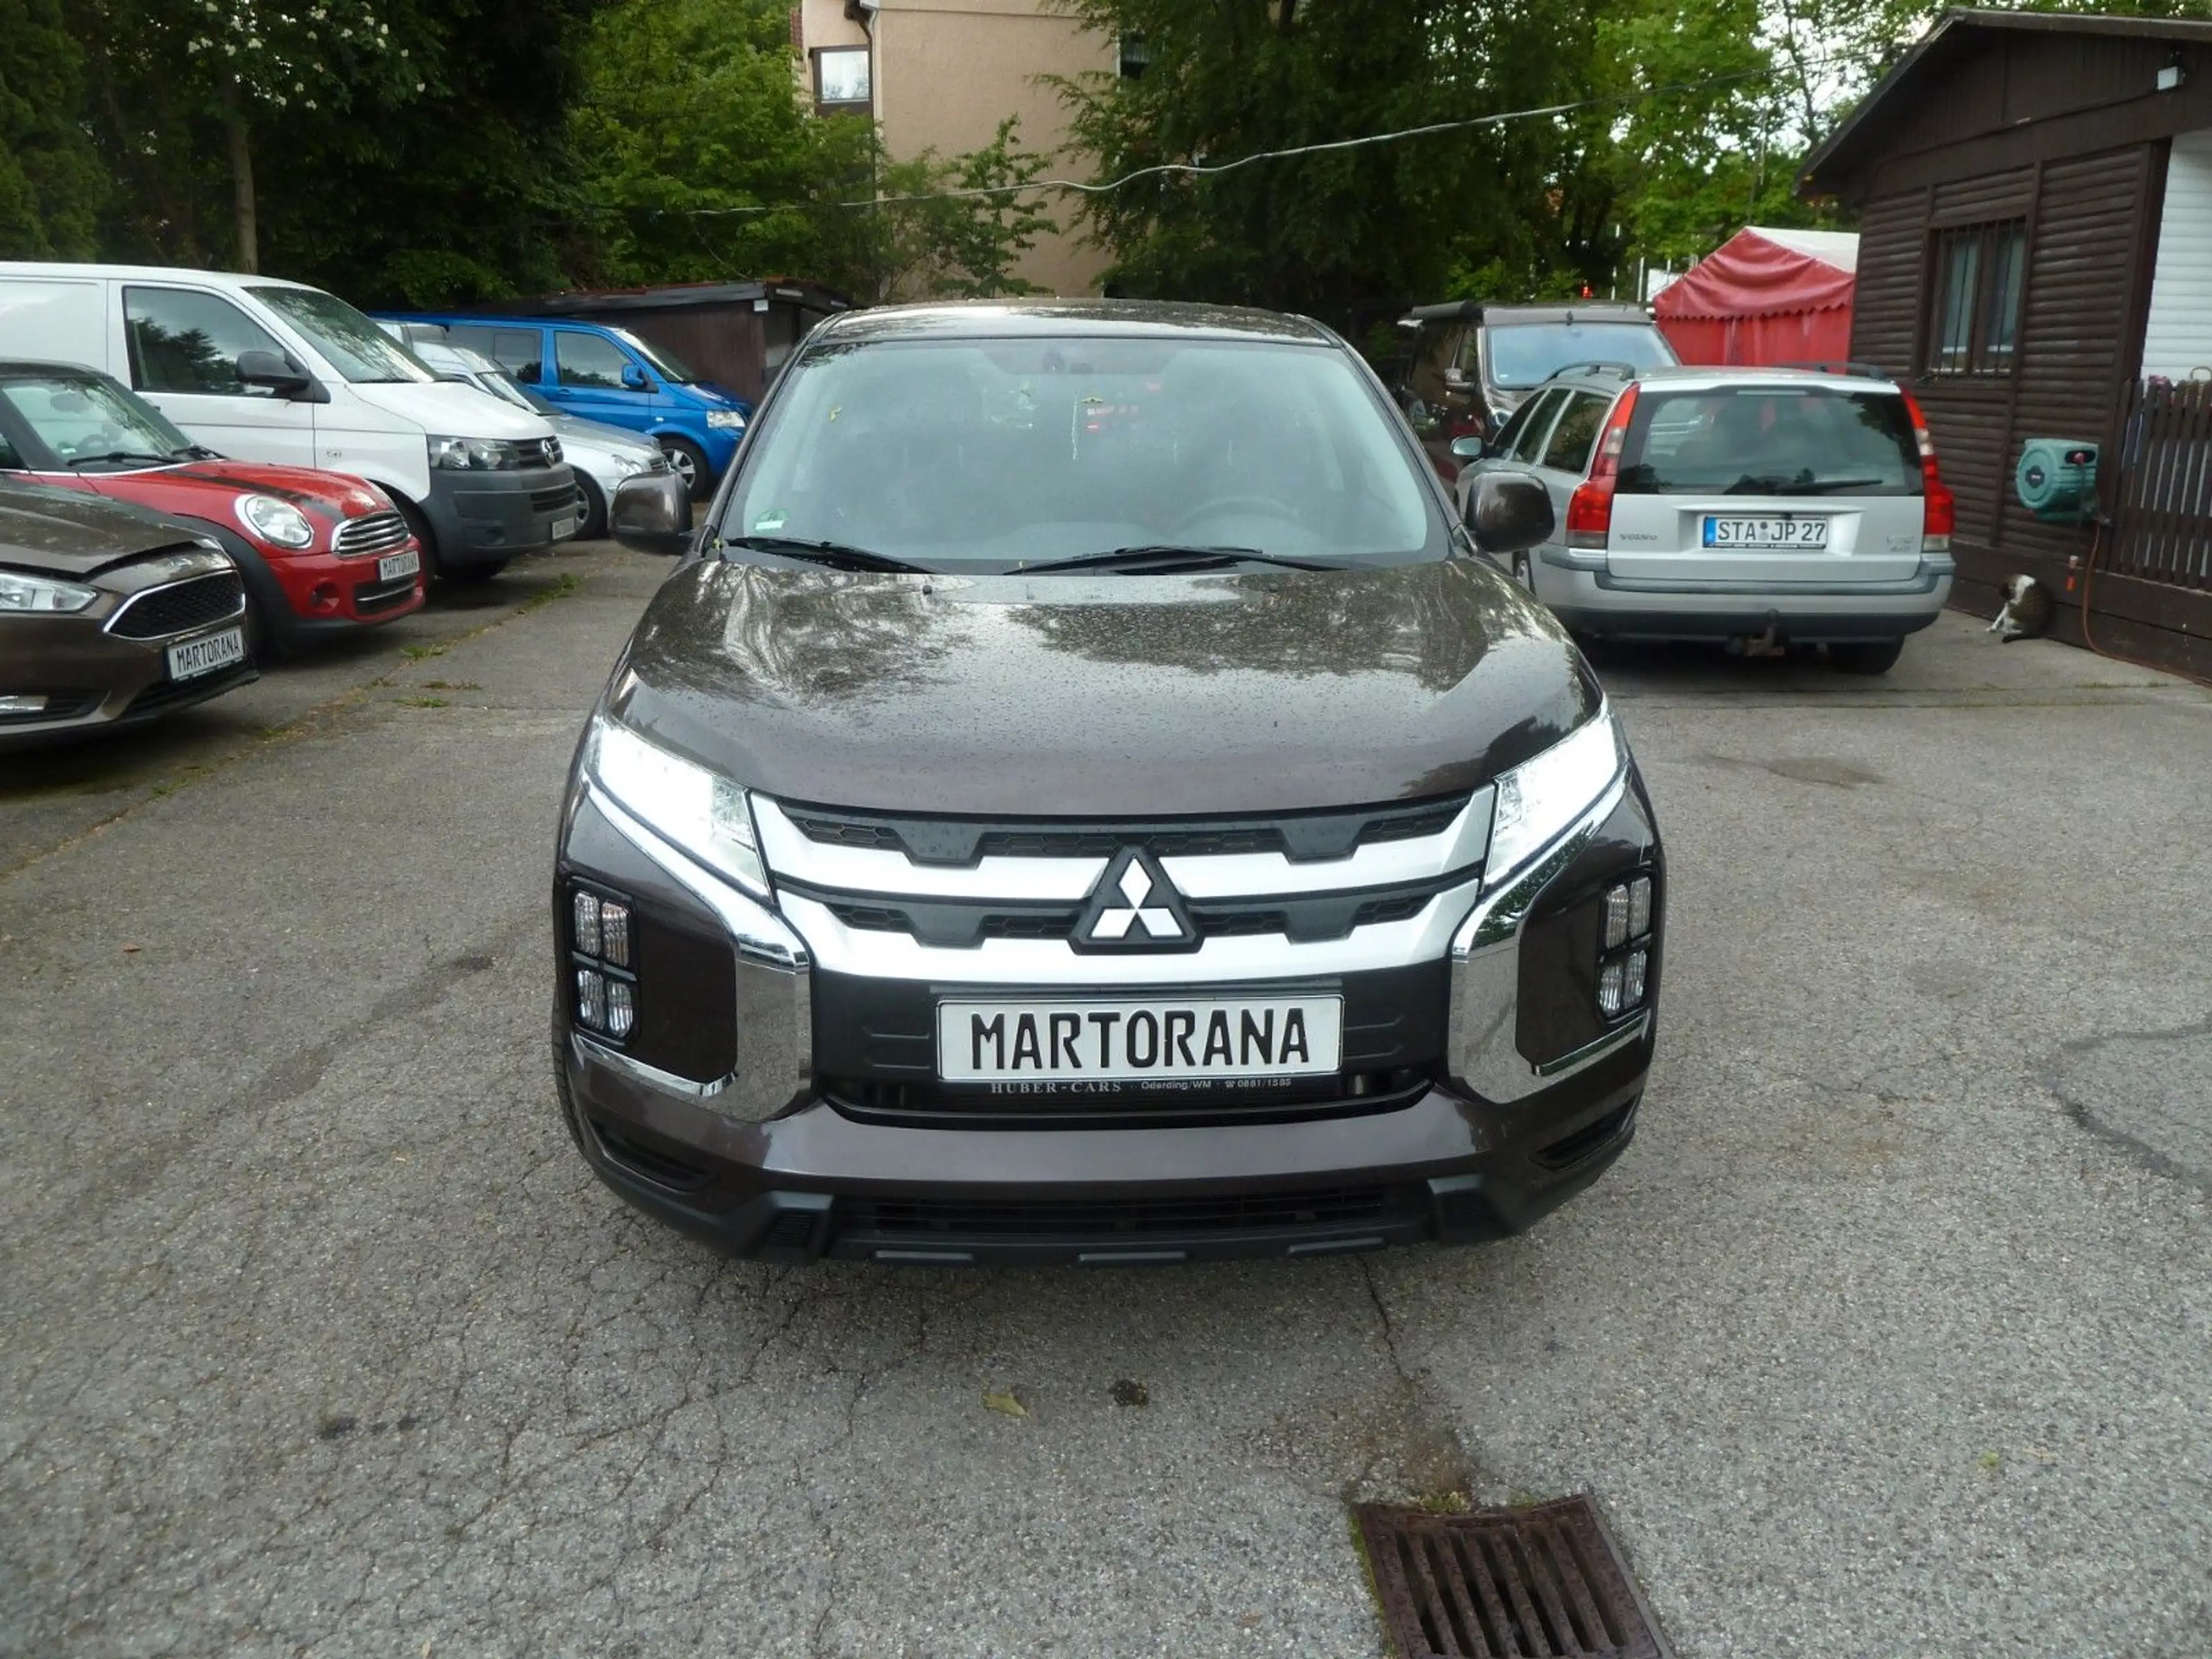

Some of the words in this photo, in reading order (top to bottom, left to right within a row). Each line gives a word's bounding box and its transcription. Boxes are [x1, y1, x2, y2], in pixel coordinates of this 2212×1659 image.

[1717, 521, 1756, 540] STA
[1771, 522, 1797, 541] JP
[1801, 522, 1826, 541] 27
[382, 554, 418, 577] MARTORANA
[176, 632, 240, 673] MARTORANA
[971, 1007, 1309, 1070] MARTORANA
